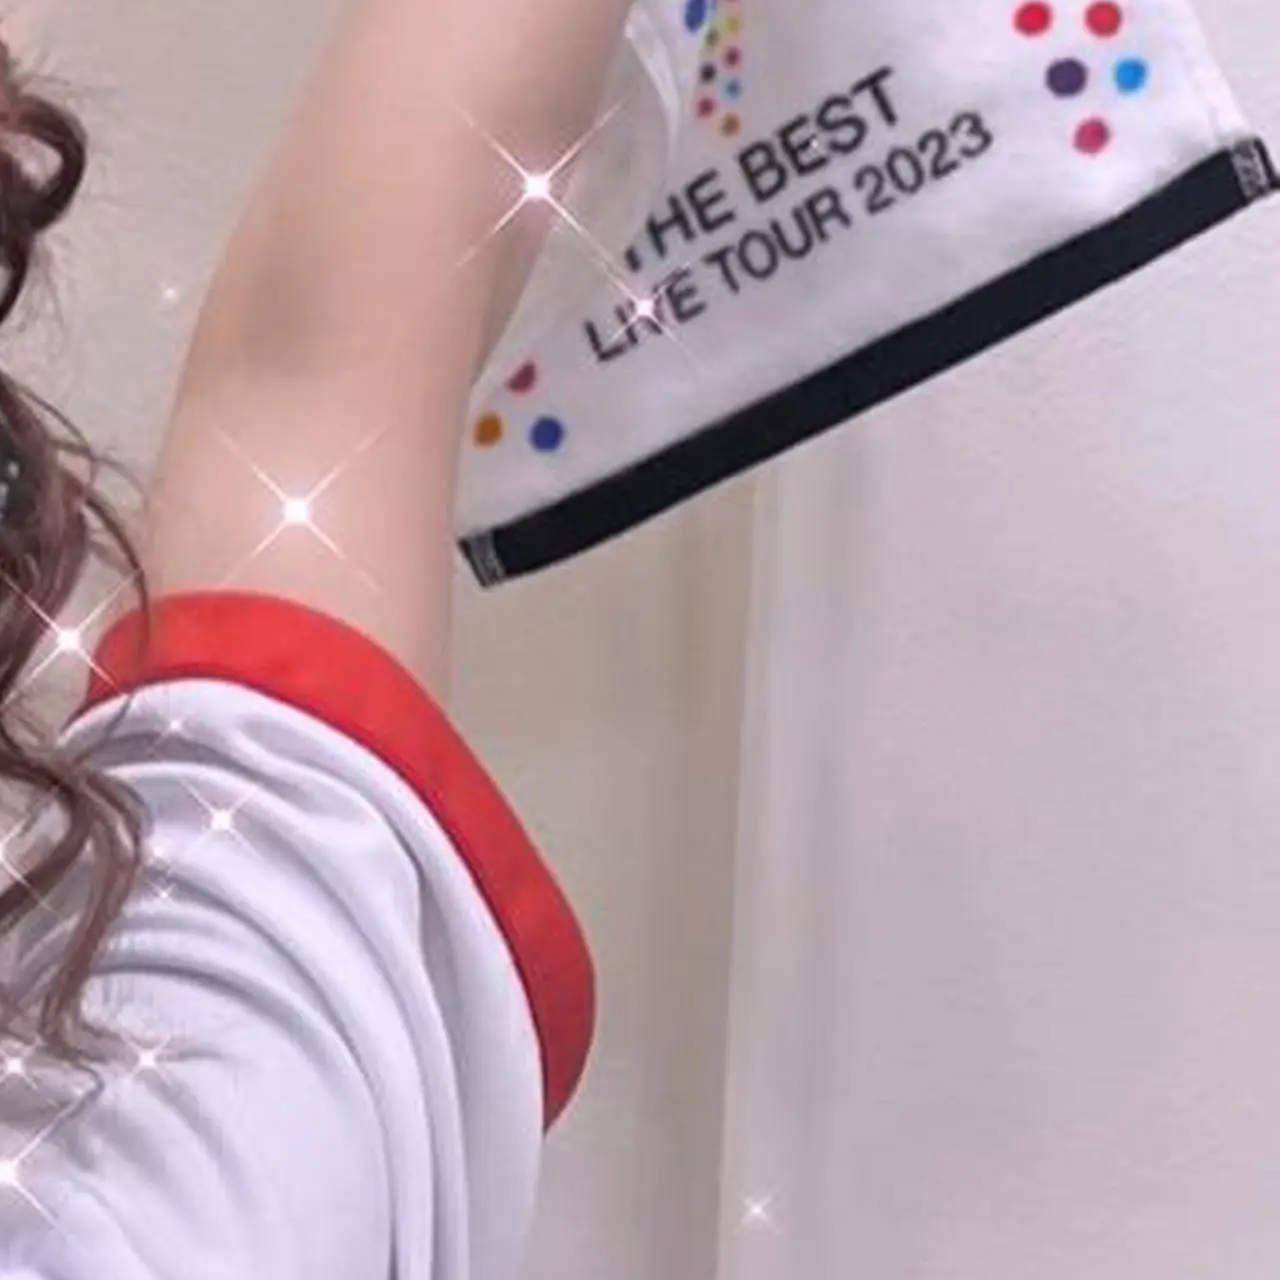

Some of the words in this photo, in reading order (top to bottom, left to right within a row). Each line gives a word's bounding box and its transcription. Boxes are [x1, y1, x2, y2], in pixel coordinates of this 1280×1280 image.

[704, 185, 854, 294] TOUR
[854, 110, 994, 216] 2023
[738, 65, 899, 204] BEST
